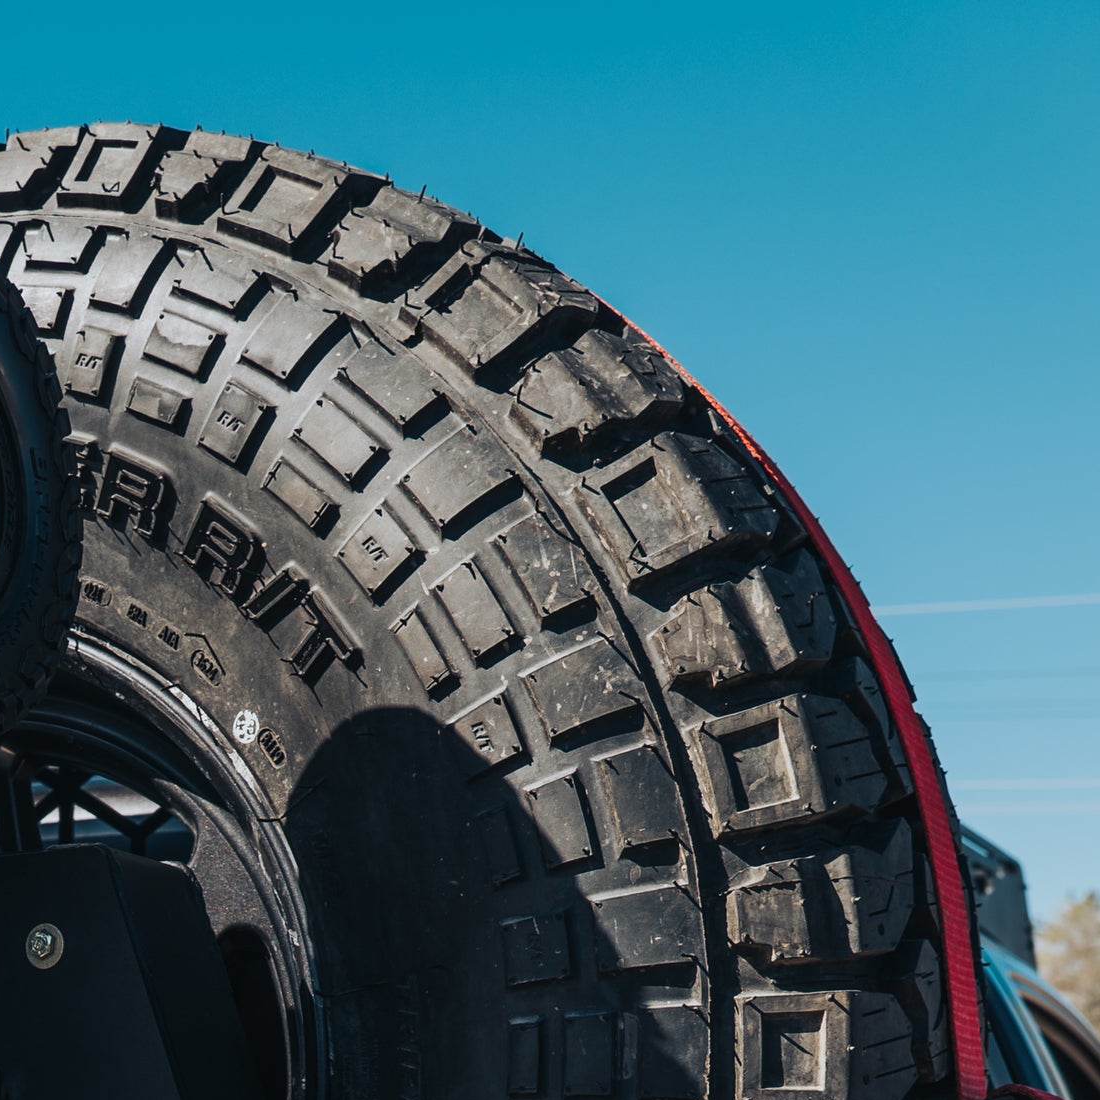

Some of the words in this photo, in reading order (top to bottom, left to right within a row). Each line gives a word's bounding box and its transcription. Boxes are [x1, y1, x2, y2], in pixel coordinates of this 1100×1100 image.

[75, 353, 103, 370] R/T
[216, 410, 245, 432] R/T
[362, 536, 388, 562] R/T
[182, 495, 360, 678] R/T
[471, 721, 494, 753] R/T
